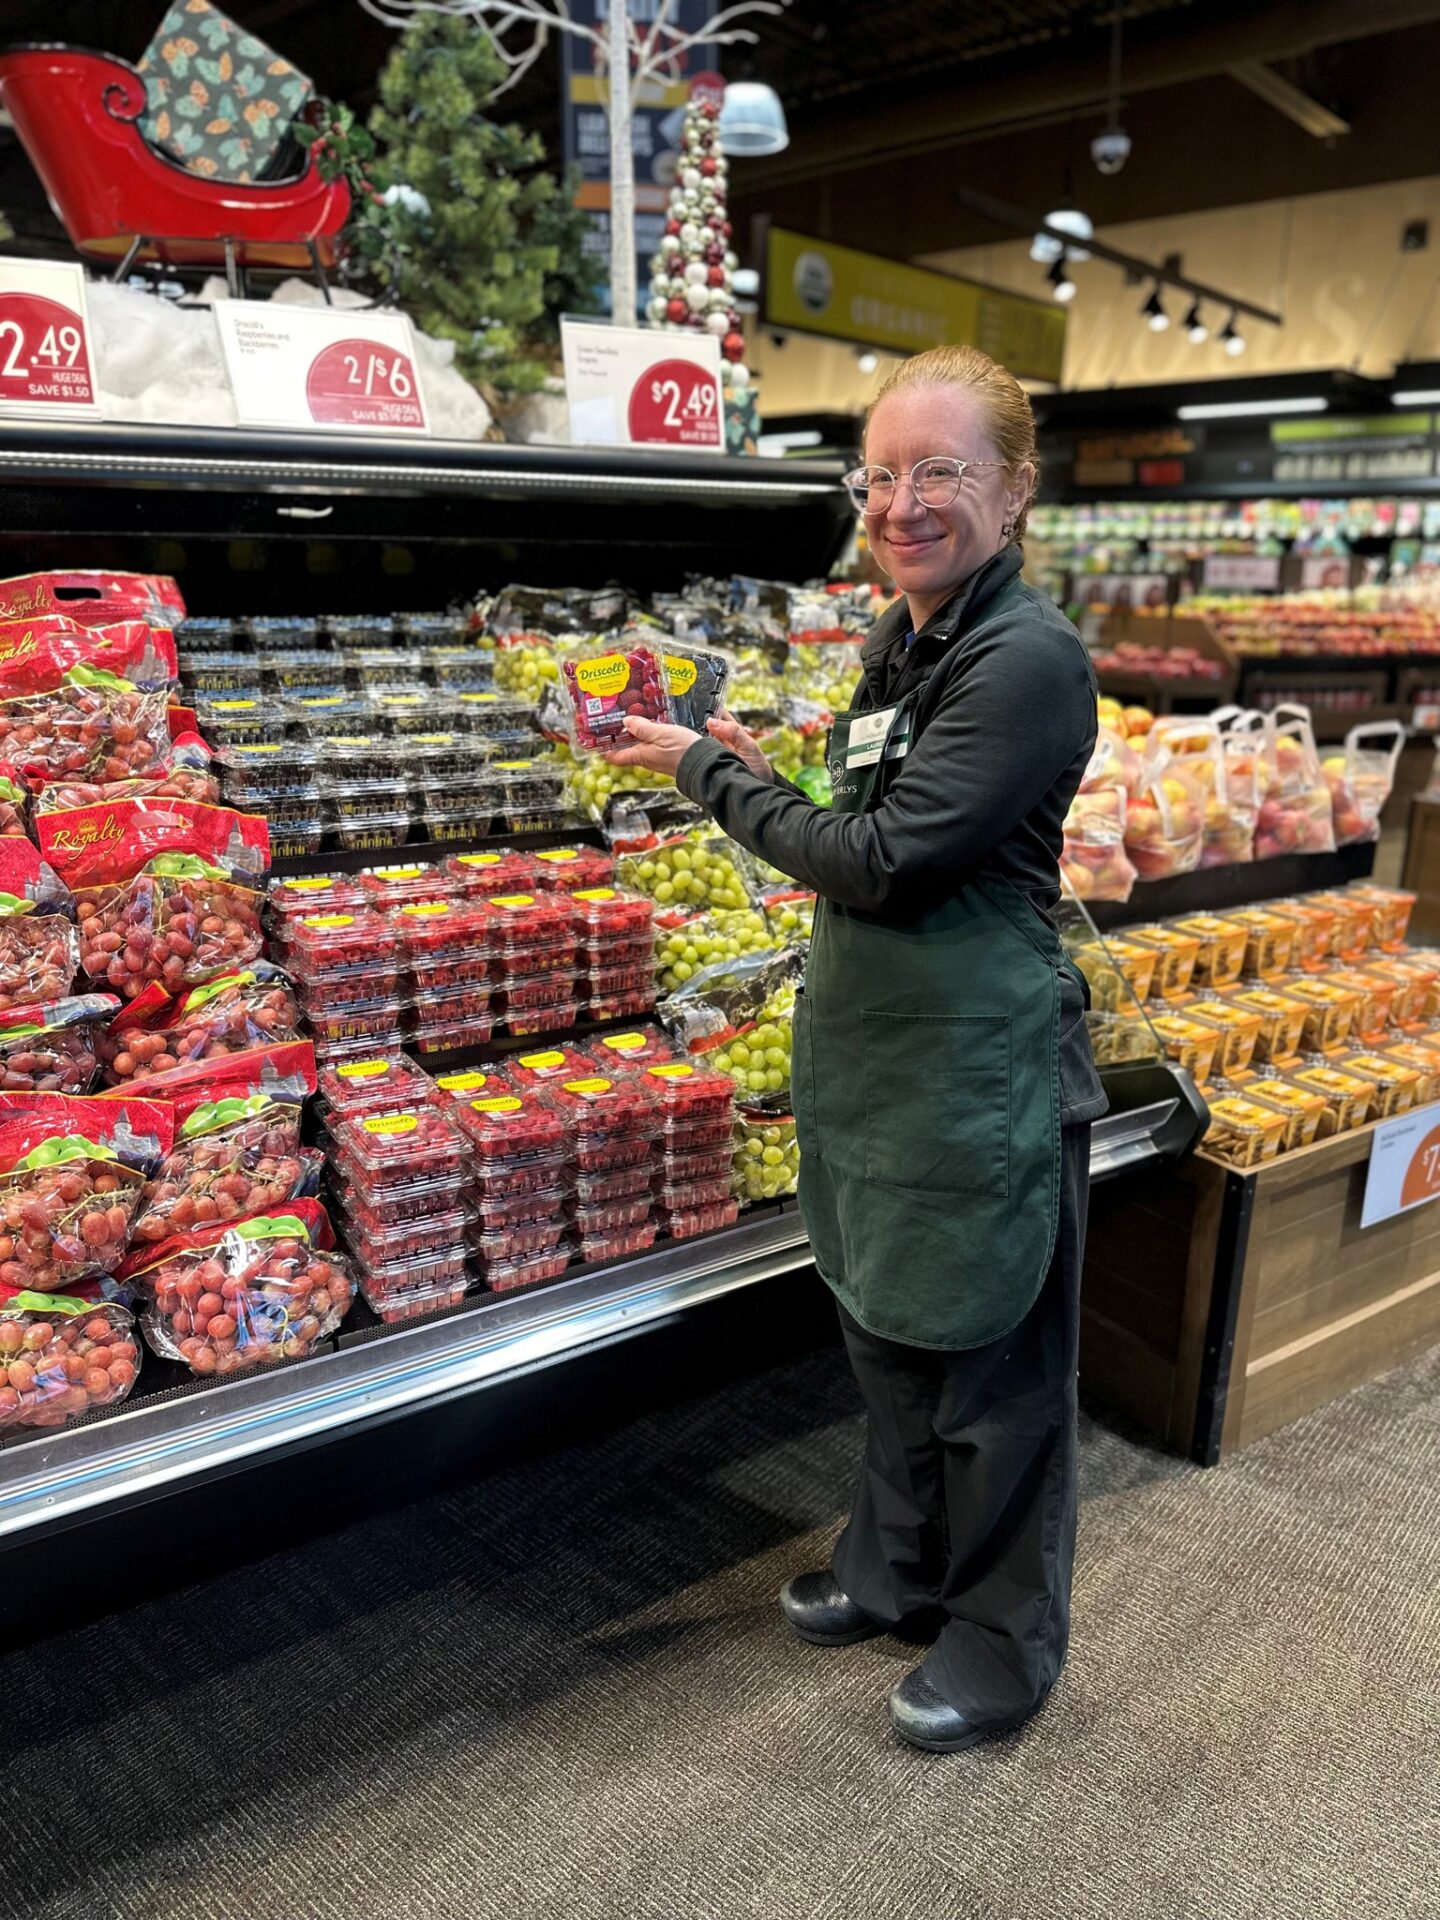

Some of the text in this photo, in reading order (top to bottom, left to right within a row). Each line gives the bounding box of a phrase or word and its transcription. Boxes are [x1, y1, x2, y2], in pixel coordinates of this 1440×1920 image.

[28, 383, 90, 398] SAVE $1.50
[651, 380, 716, 427] $2.49
[0, 631, 39, 666] yalty
[580, 662, 627, 681] Driscoll's
[664, 664, 695, 680] scoll's
[48, 814, 125, 861] Royalty
